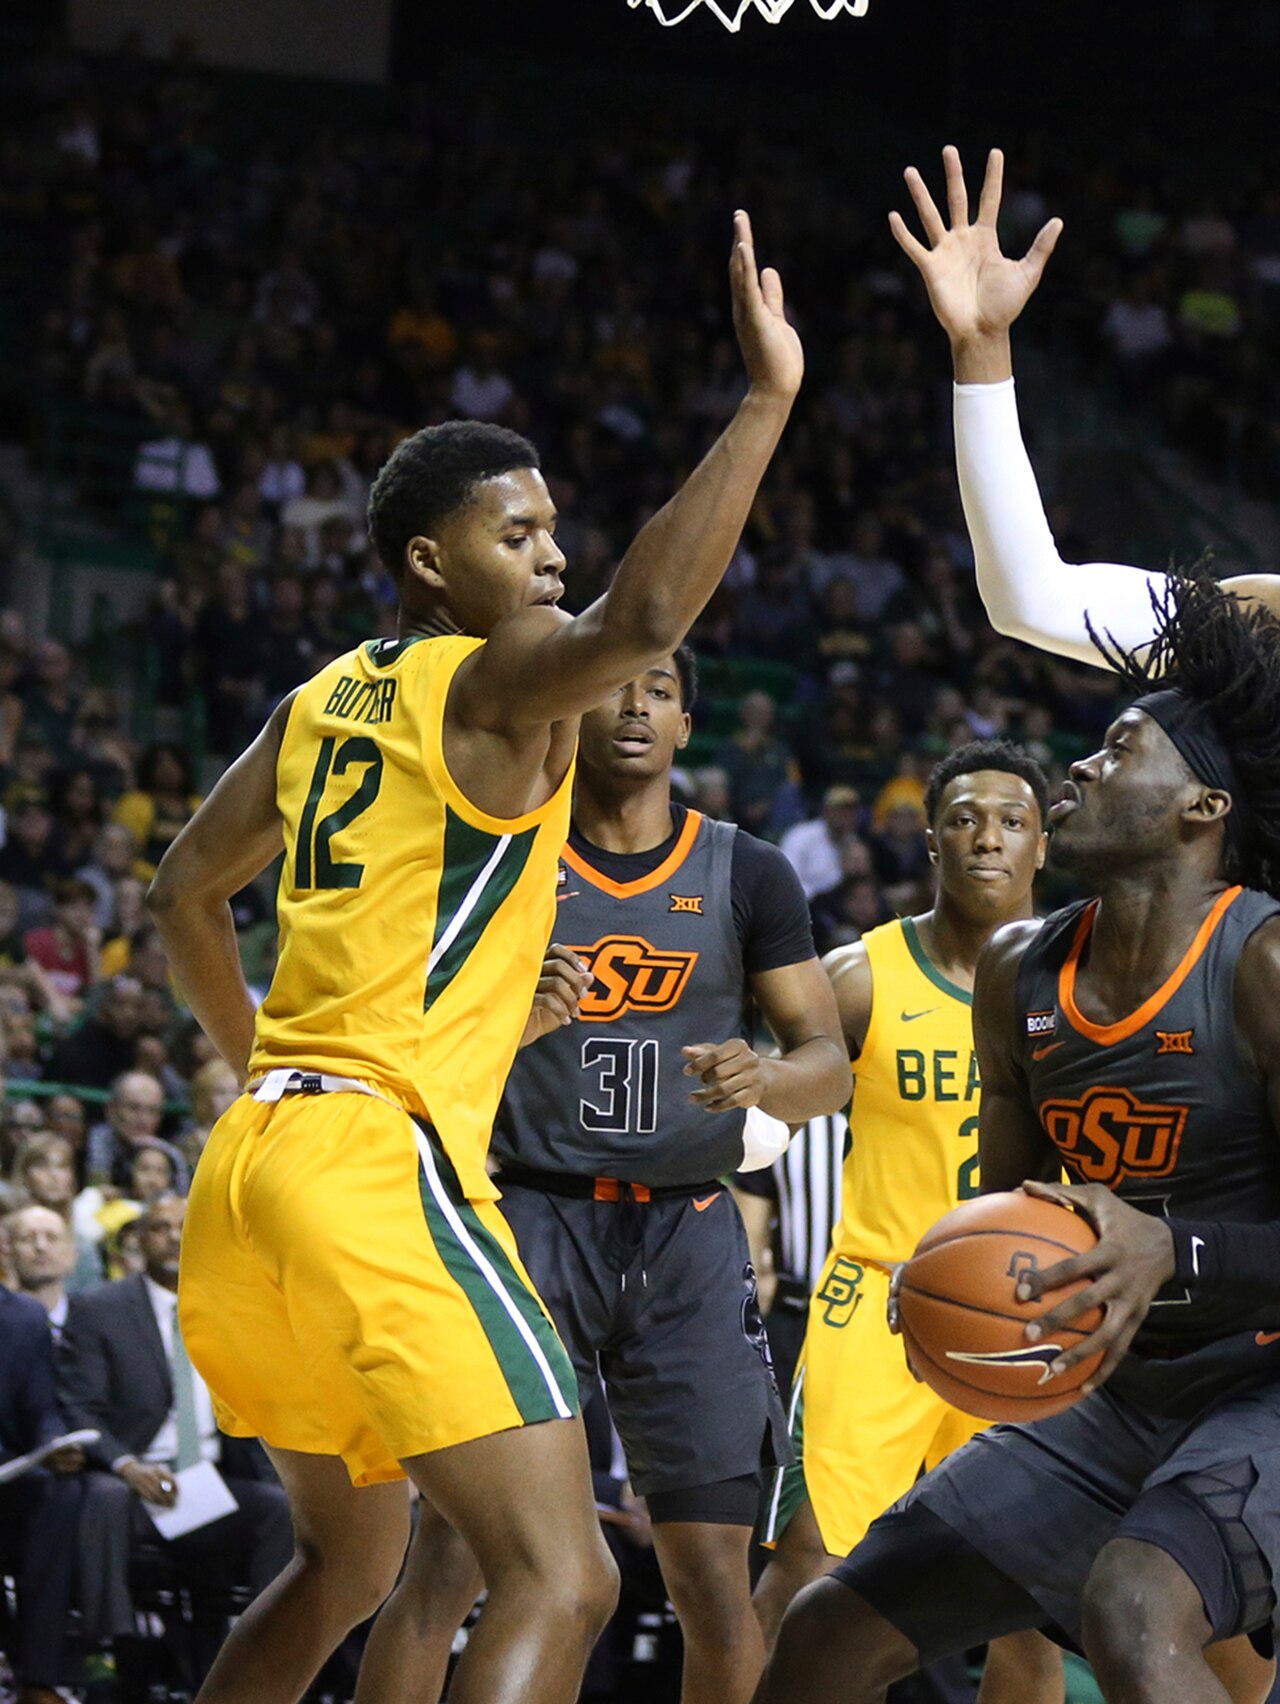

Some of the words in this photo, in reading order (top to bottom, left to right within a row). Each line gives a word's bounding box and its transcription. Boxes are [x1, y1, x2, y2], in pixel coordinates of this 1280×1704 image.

[295, 736, 384, 889] 12
[579, 1038, 659, 1133] 31
[1040, 1086, 1190, 1192] OSU
